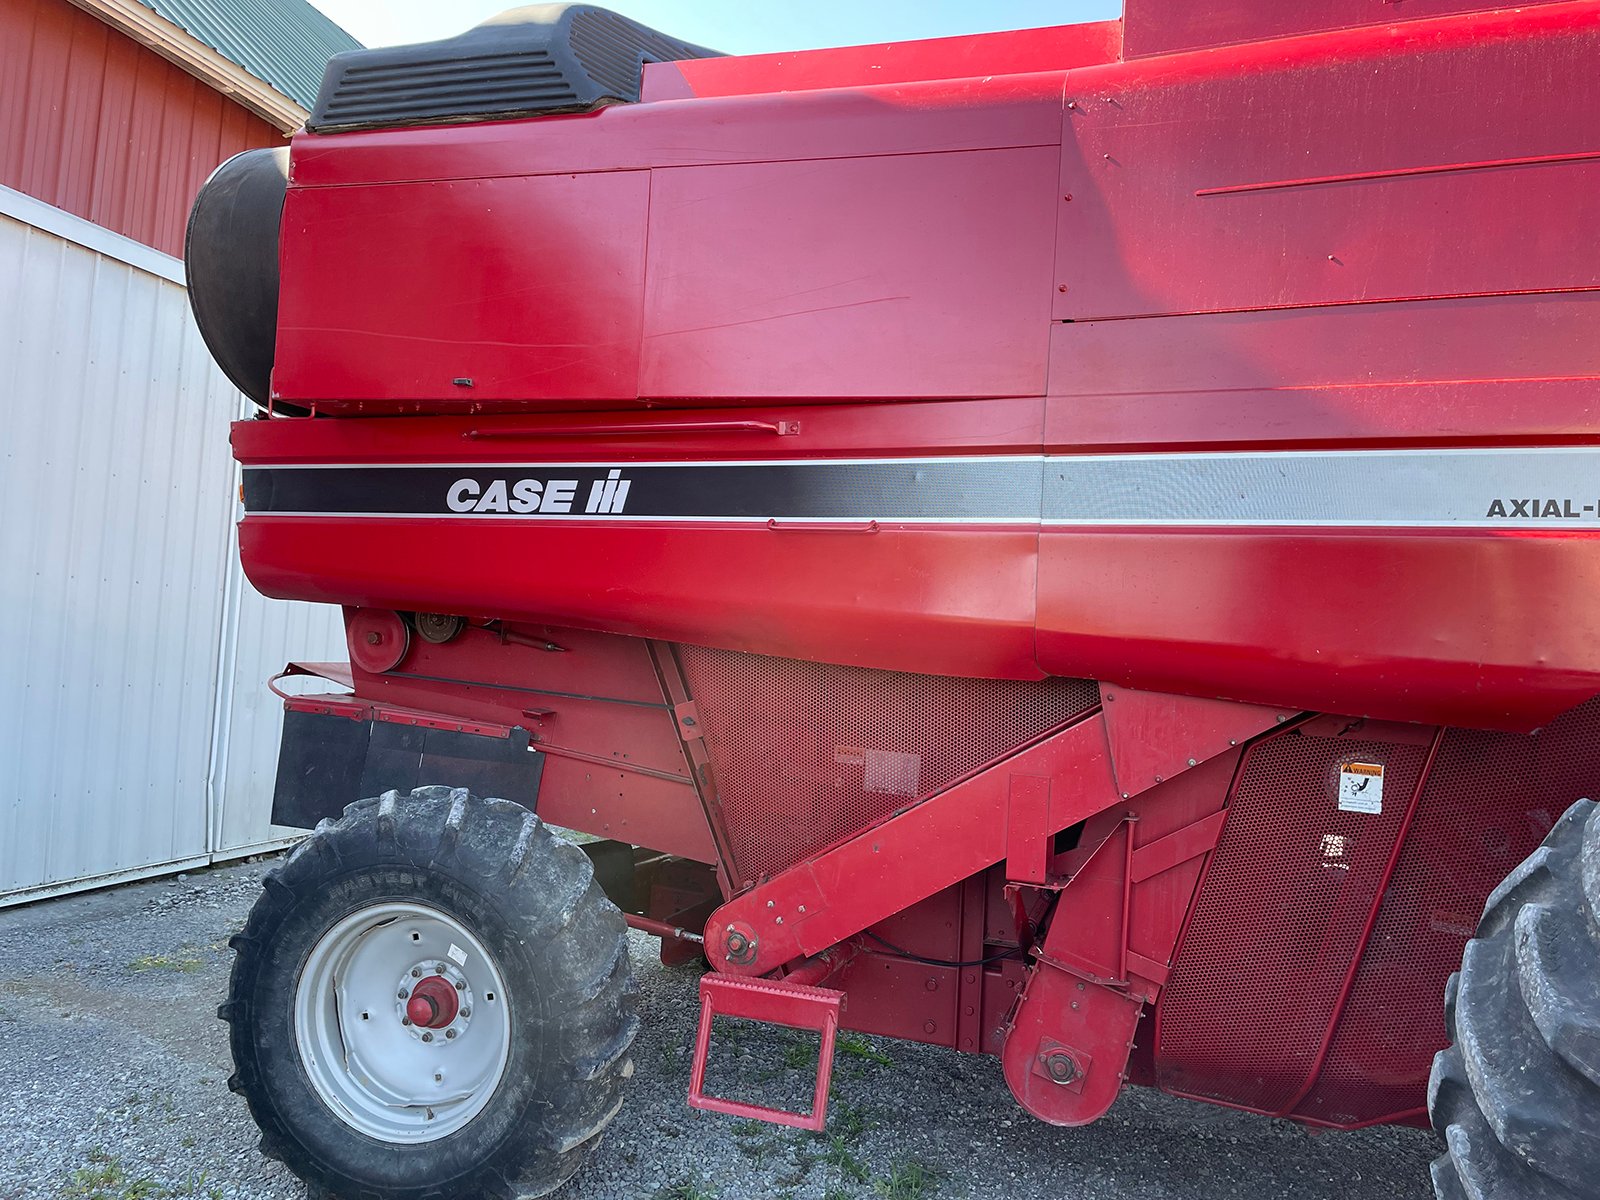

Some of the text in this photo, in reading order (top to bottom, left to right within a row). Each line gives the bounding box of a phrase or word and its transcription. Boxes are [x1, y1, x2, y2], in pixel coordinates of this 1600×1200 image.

[446, 478, 579, 513] CASE
[1486, 499, 1600, 518] AXIAL-
[1353, 767, 1381, 777] WARNING
